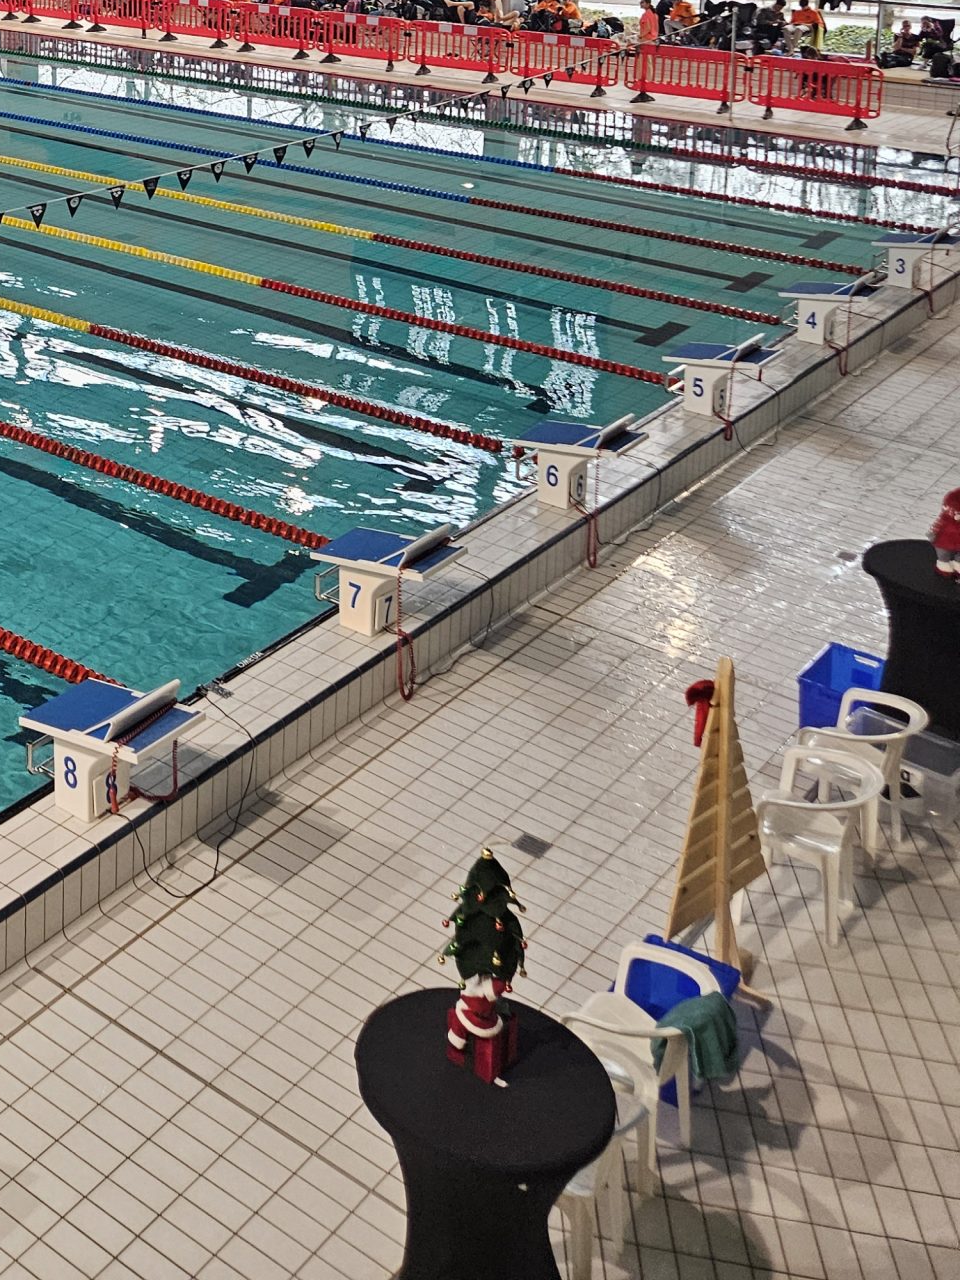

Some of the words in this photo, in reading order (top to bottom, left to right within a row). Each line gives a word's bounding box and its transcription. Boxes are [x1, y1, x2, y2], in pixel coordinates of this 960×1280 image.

[895, 258, 905, 274] 3
[805, 312, 817, 329] 4
[693, 377, 704, 397] 5
[546, 464, 558, 487] 6
[576, 474, 584, 497] 6
[348, 581, 361, 608] 7
[64, 756, 77, 789] 8
[106, 771, 117, 804] 8
